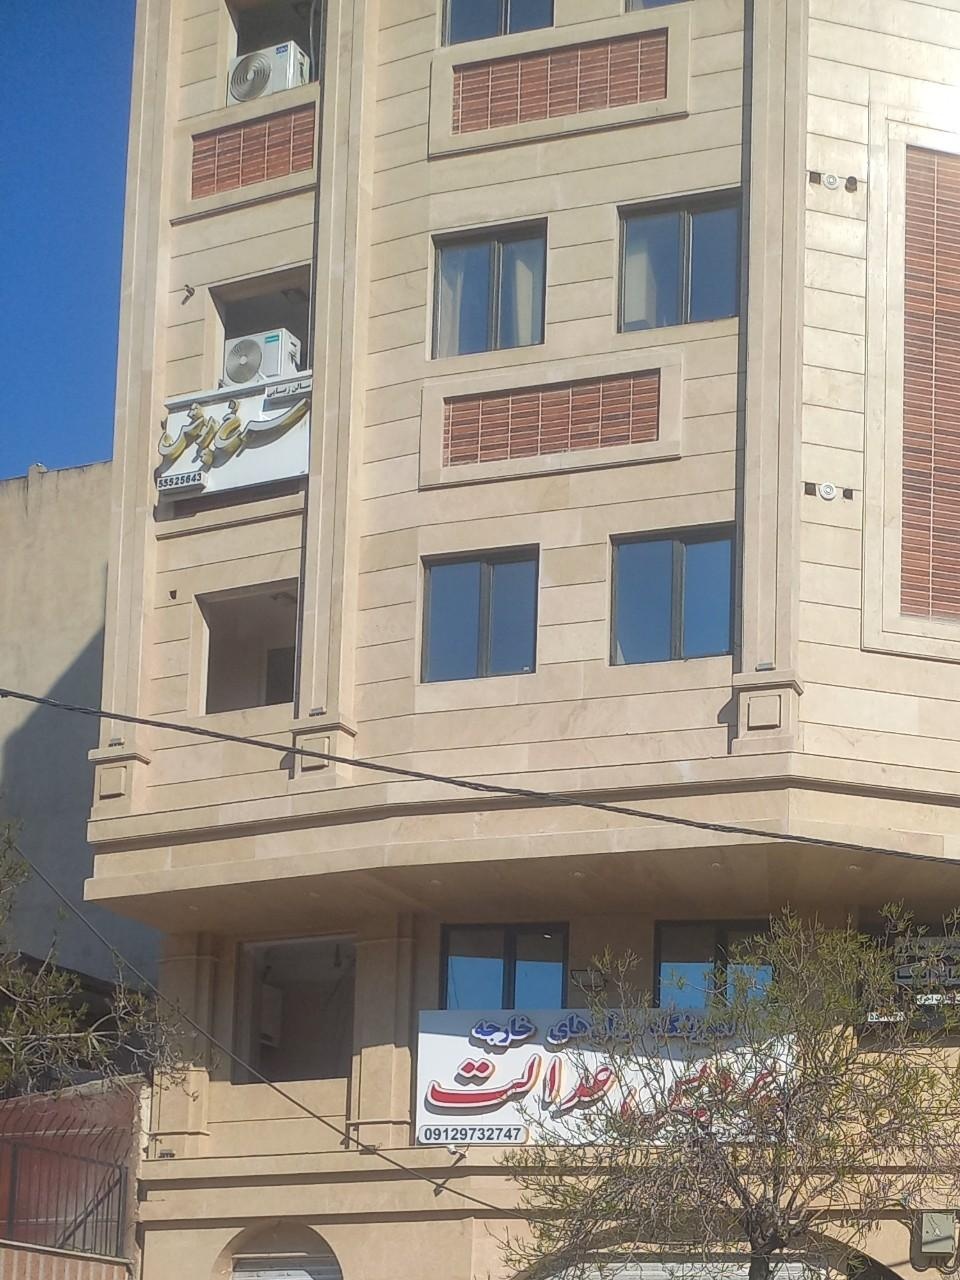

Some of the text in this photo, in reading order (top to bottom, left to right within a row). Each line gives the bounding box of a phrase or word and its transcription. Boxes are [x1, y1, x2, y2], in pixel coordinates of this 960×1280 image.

[266, 383, 311, 398] سالن زیبایی
[158, 473, 202, 488] 55525643
[471, 1014, 535, 1046] خارجه
[425, 1054, 614, 1110] عدالت
[424, 1127, 521, 1141] 09129732747
